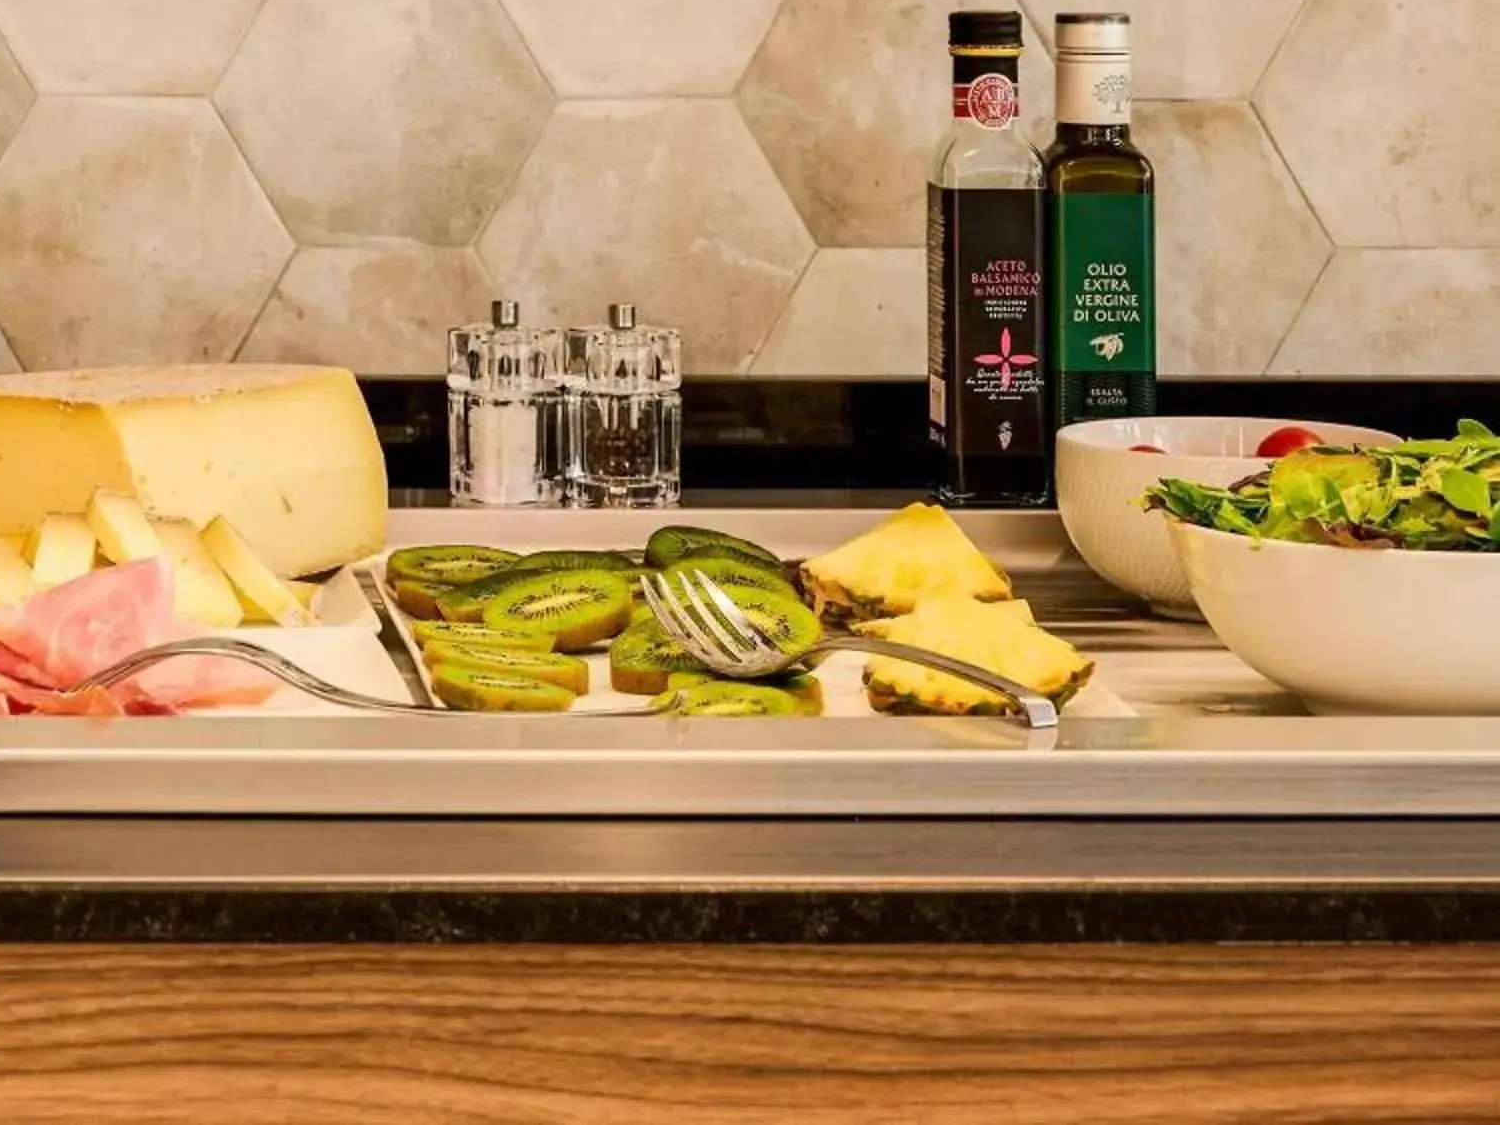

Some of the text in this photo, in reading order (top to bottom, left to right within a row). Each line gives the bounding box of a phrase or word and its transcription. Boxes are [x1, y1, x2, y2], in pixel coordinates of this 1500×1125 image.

[986, 260, 1027, 272] ACETO
[1087, 263, 1127, 276] OLIO
[971, 272, 1041, 284] BALSAMICO
[985, 285, 1038, 296] MODENA
[1083, 278, 1131, 291] EXTRA
[1075, 294, 1139, 307] VERGINE
[1074, 310, 1141, 322] DI OLIVA
